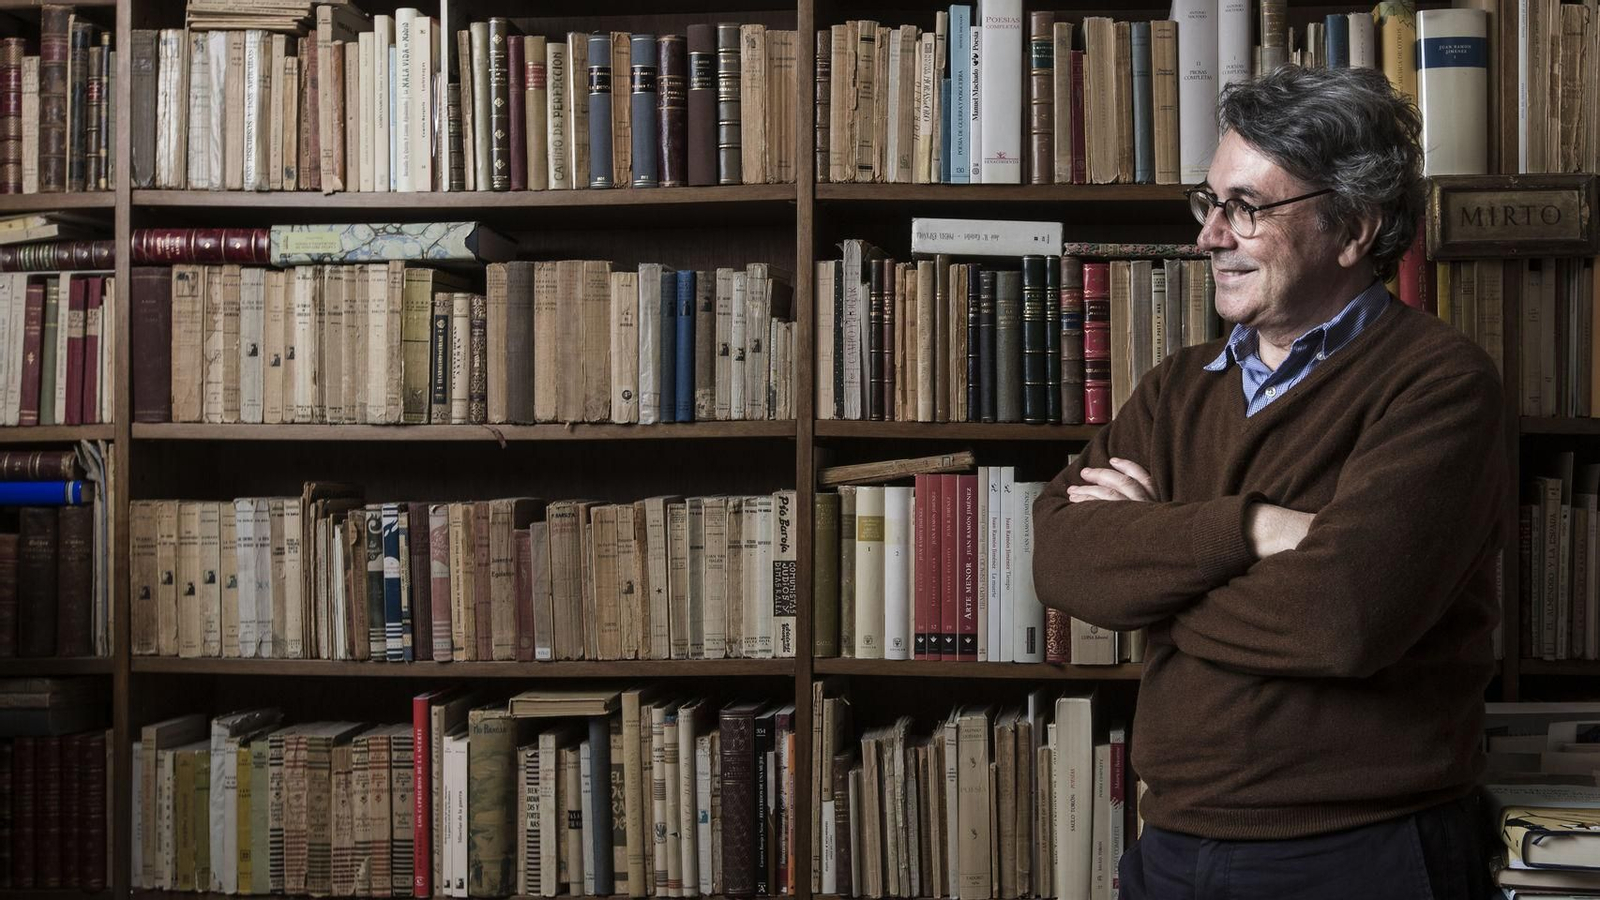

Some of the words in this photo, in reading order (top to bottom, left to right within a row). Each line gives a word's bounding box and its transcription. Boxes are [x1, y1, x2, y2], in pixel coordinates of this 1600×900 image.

[554, 120, 564, 136] DE
[554, 140, 565, 181] CAMINO
[1461, 205, 1560, 226] MIRTO
[964, 487, 972, 515] JIMÉNEZ
[778, 517, 790, 553] Baroja
[782, 605, 789, 614] Y
[417, 755, 422, 763] LA
